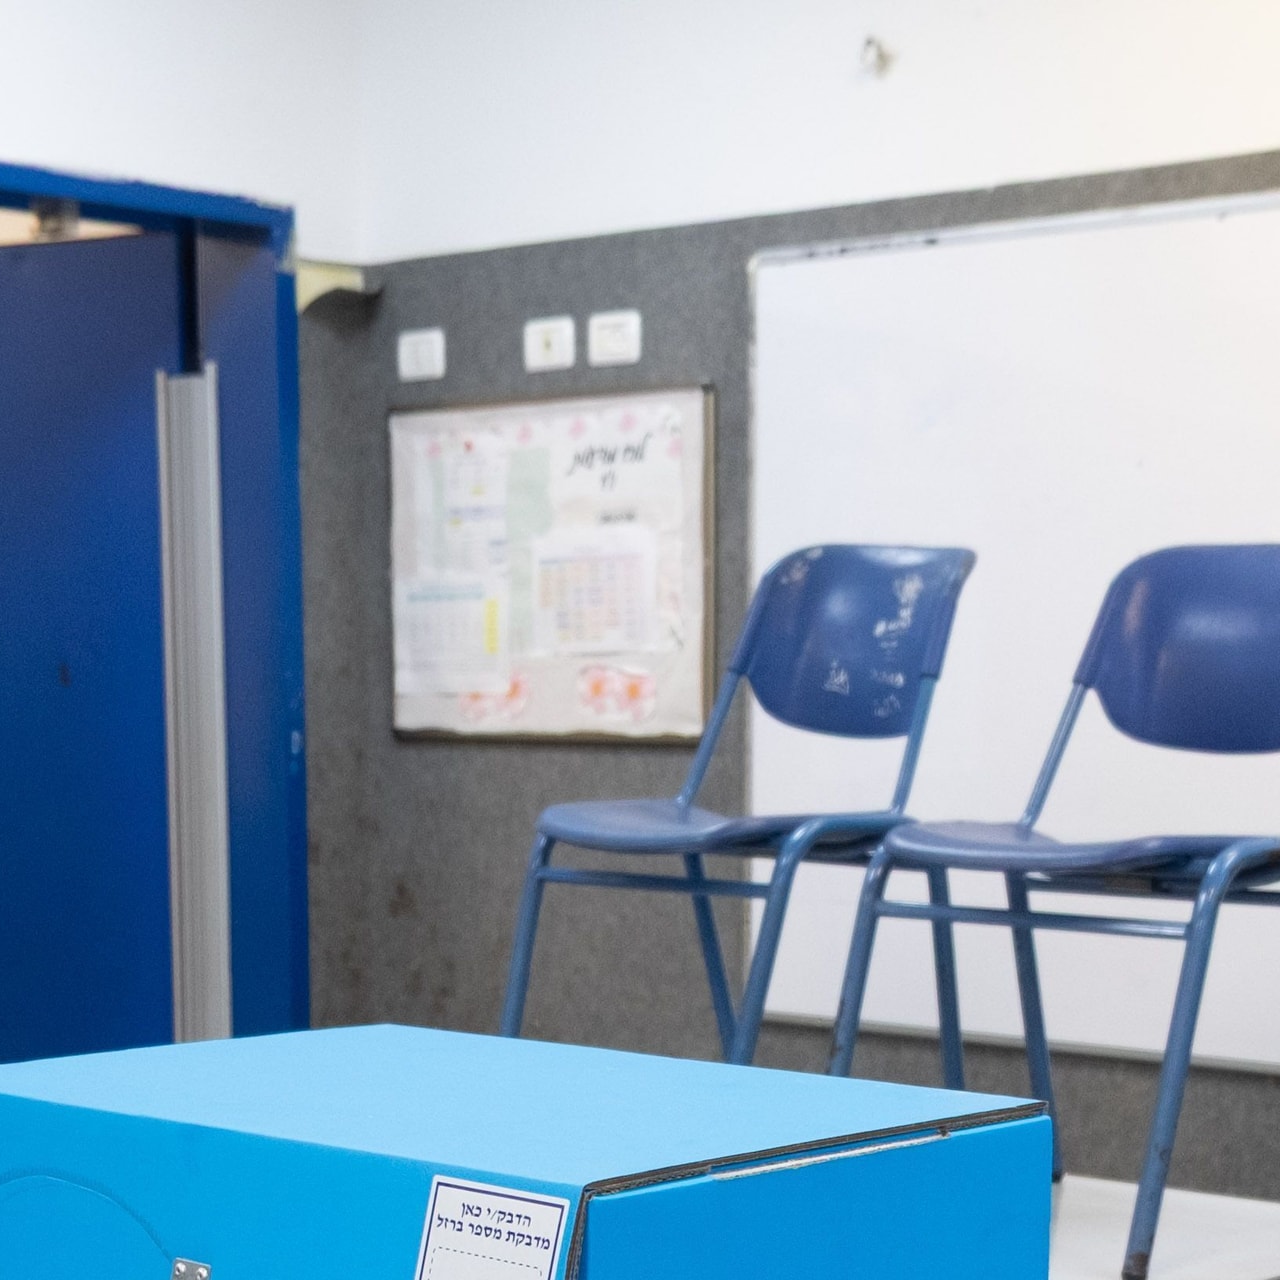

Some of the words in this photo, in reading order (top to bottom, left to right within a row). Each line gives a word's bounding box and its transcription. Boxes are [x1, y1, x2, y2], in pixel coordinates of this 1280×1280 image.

[461, 1202, 482, 1217] כאן
[486, 1208, 532, 1227] הדבק/י
[436, 1213, 463, 1232] ברזל
[468, 1221, 502, 1240] מספר
[505, 1230, 551, 1250] מדבקת
